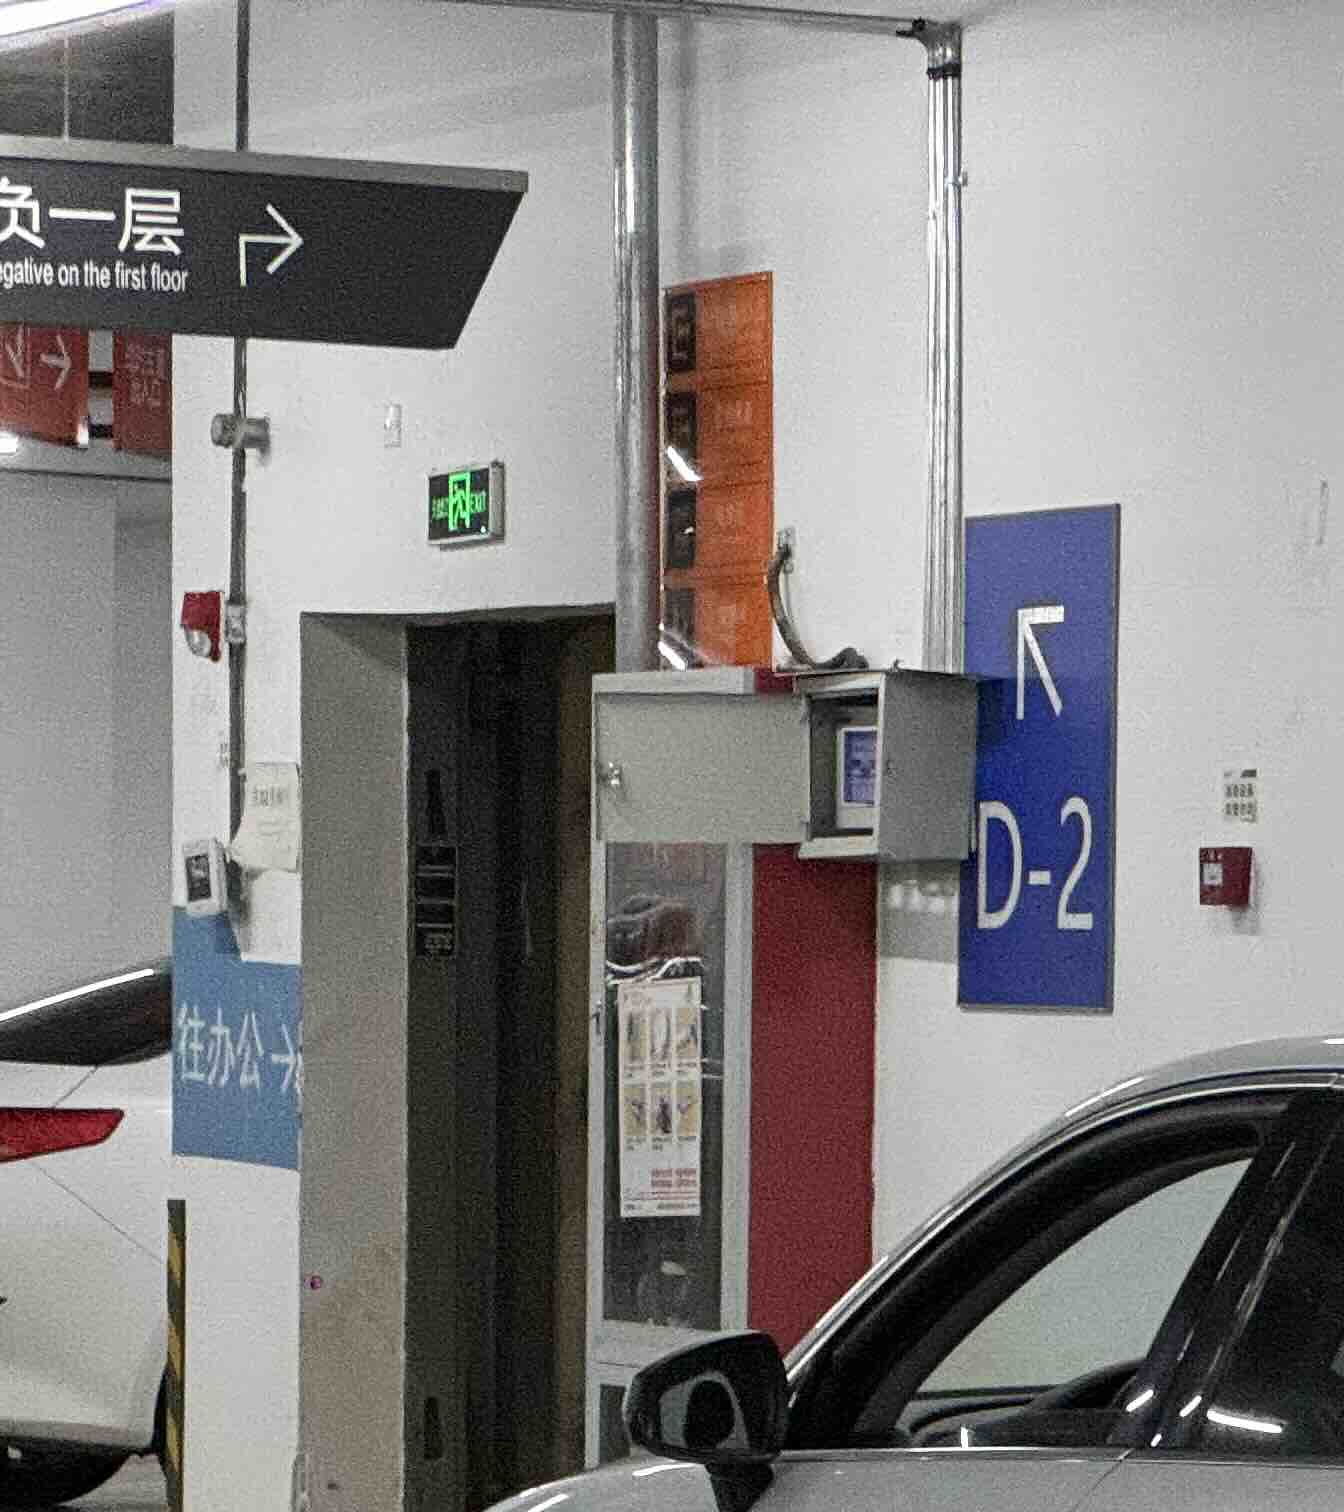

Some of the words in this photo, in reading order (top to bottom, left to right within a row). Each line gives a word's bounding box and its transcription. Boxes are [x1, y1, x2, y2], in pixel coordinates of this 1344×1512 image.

[0, 176, 185, 256] 负一层
[58, 264, 80, 288] on
[84, 258, 111, 289] the
[115, 259, 147, 291] first
[151, 260, 189, 292] floor
[977, 796, 1094, 930] D-2
[178, 1001, 264, 1093] 往办公
